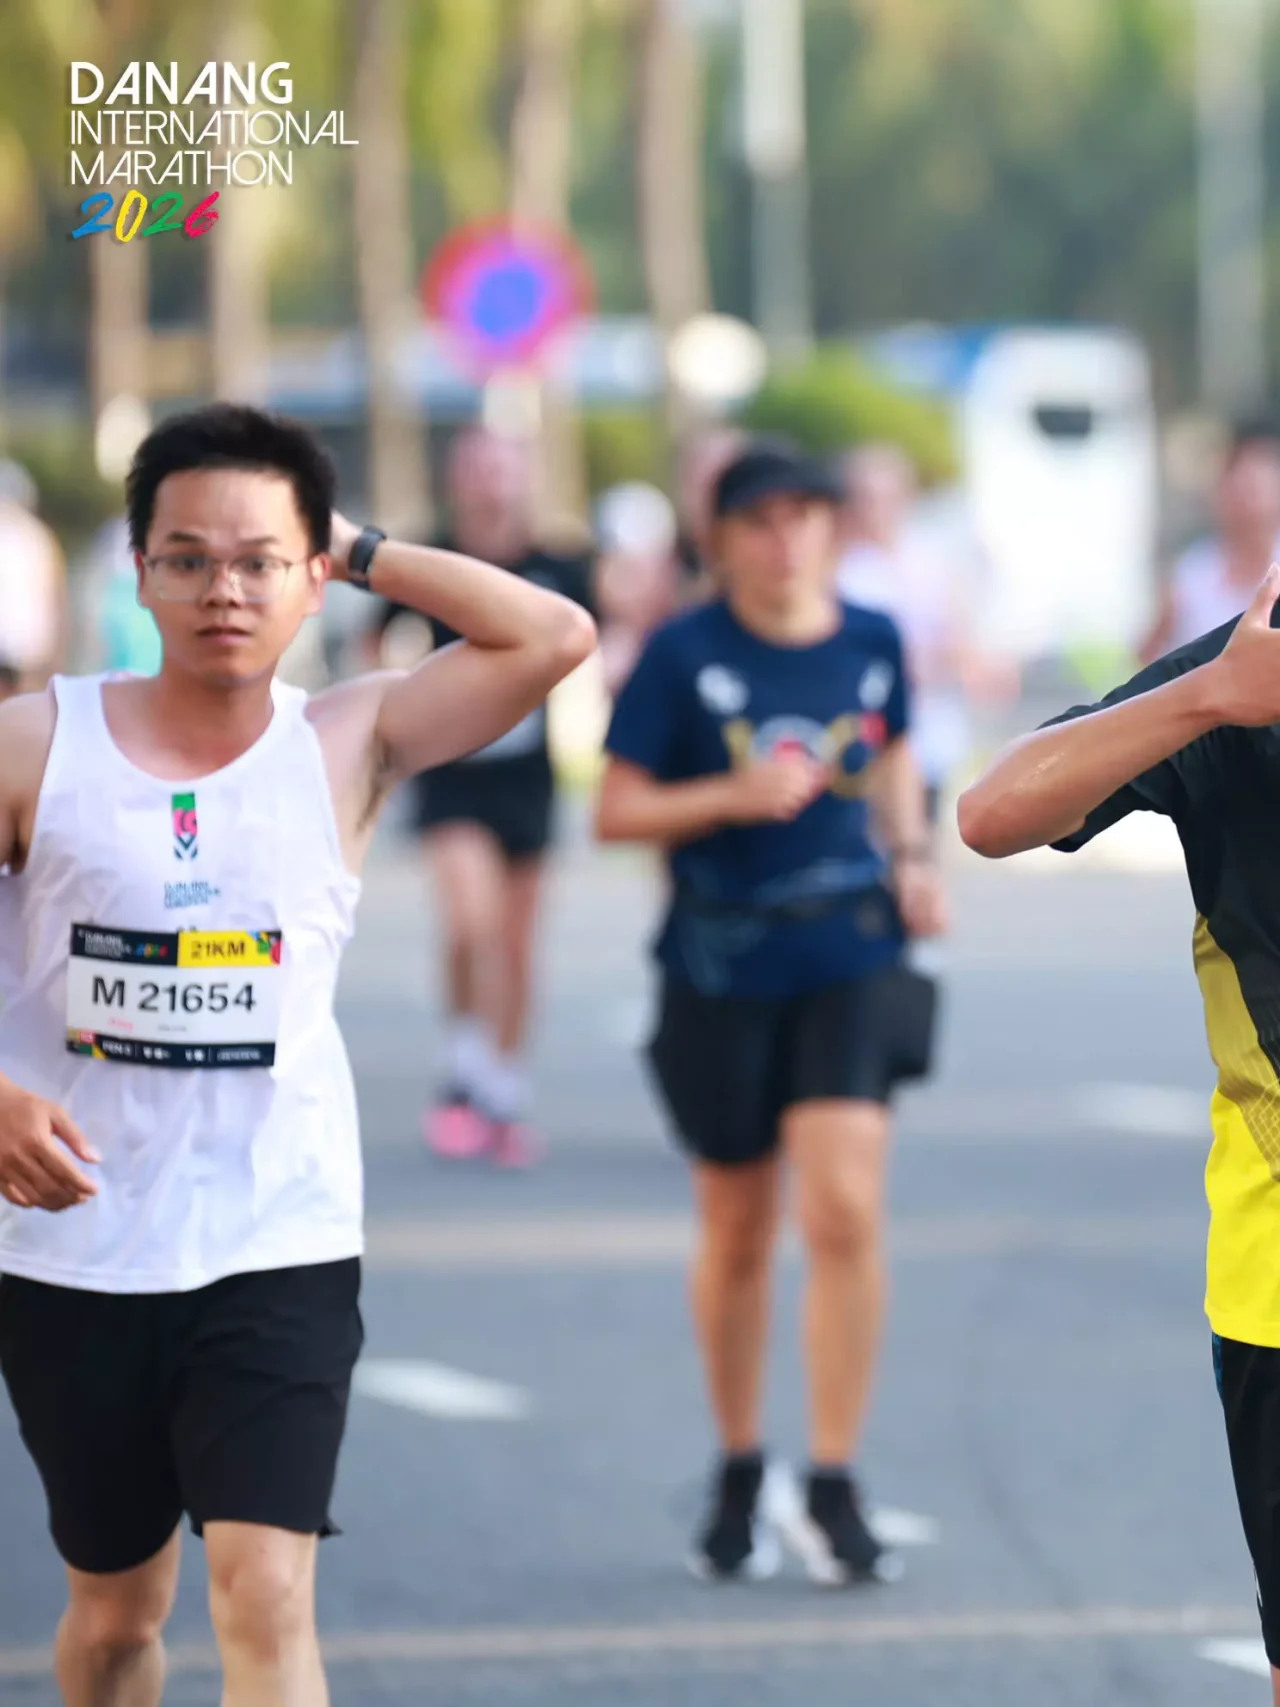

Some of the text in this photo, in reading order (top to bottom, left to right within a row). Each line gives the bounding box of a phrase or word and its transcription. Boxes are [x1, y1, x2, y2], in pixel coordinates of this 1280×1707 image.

[190, 939, 246, 959] 21KM
[92, 975, 257, 1014] M 21654
